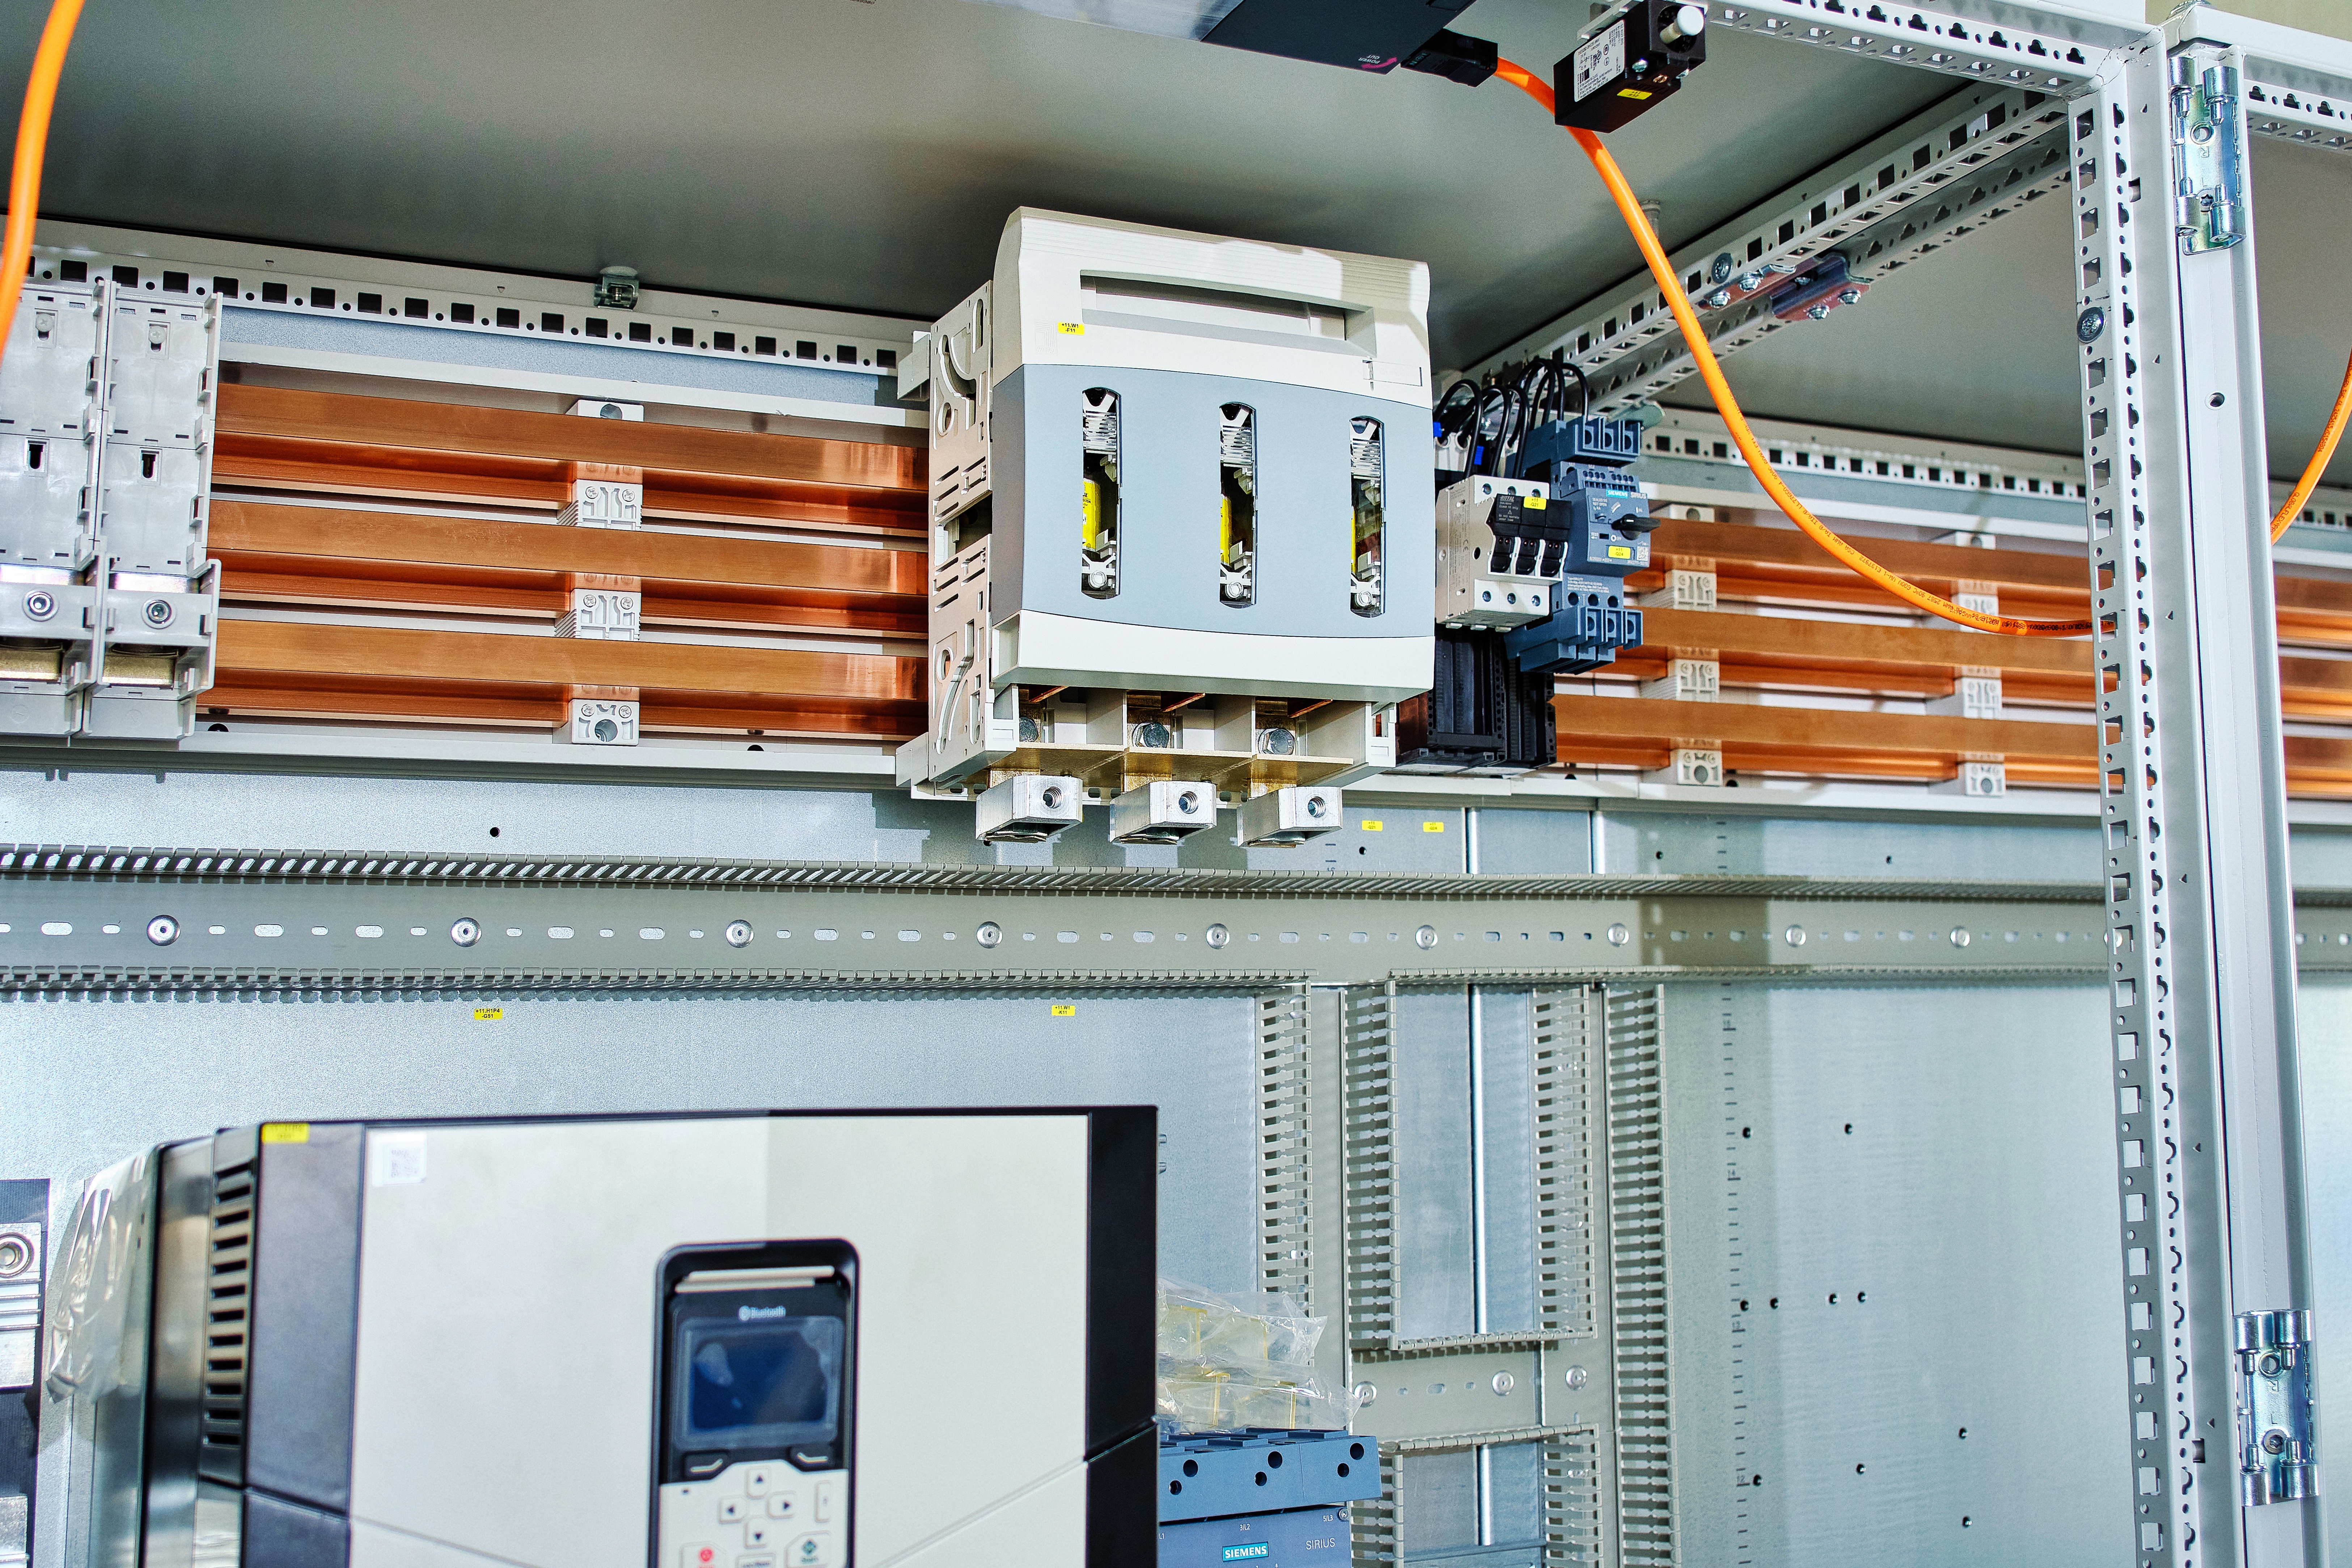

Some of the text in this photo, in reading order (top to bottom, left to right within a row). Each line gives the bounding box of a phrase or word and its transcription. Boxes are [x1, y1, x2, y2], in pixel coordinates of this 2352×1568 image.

[2198, 147, 2209, 158] R
[1832, 536, 1843, 546] AWM
[1844, 545, 1855, 555] CSA
[1858, 555, 1882, 572] E137972
[1883, 571, 1896, 582] VW-1
[1897, 580, 1911, 590] 600V
[1927, 595, 1941, 605] 2587
[2267, 1379, 2279, 1392] R
[2270, 1413, 2278, 1425] L
[1306, 1538, 1336, 1550] SIRIUS
[1225, 1545, 1267, 1559] SIEMENS
